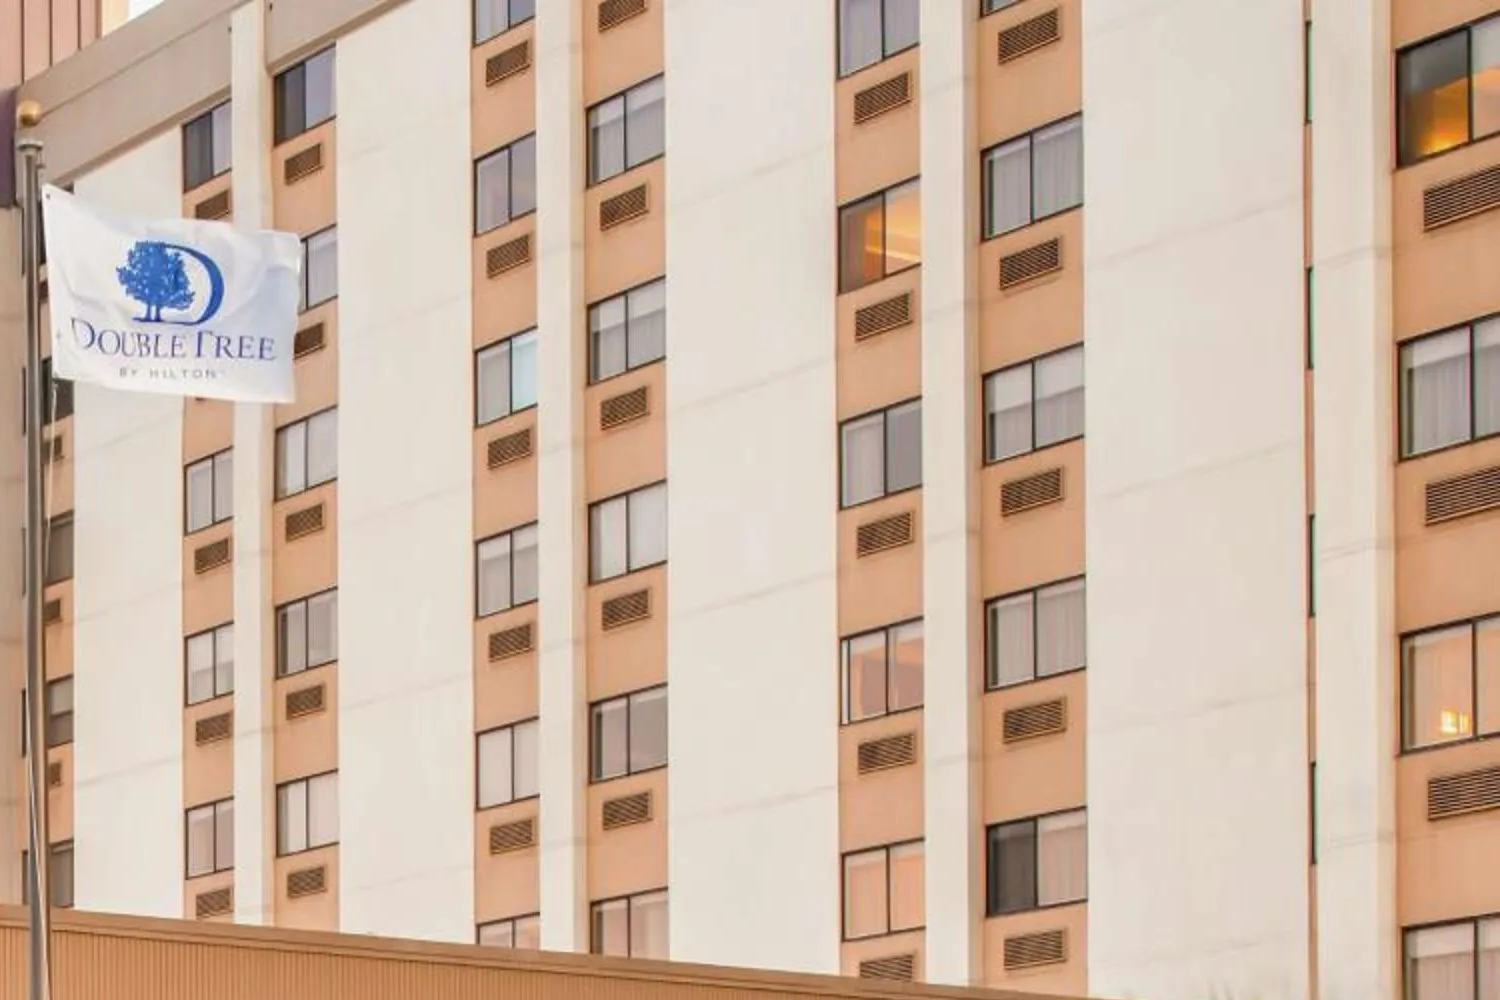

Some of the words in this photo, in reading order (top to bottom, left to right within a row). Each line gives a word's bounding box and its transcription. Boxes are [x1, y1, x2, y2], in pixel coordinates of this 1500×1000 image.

[71, 317, 277, 362] DOUBLETREE
[119, 367, 138, 378] BY
[149, 368, 217, 379] HILTON
